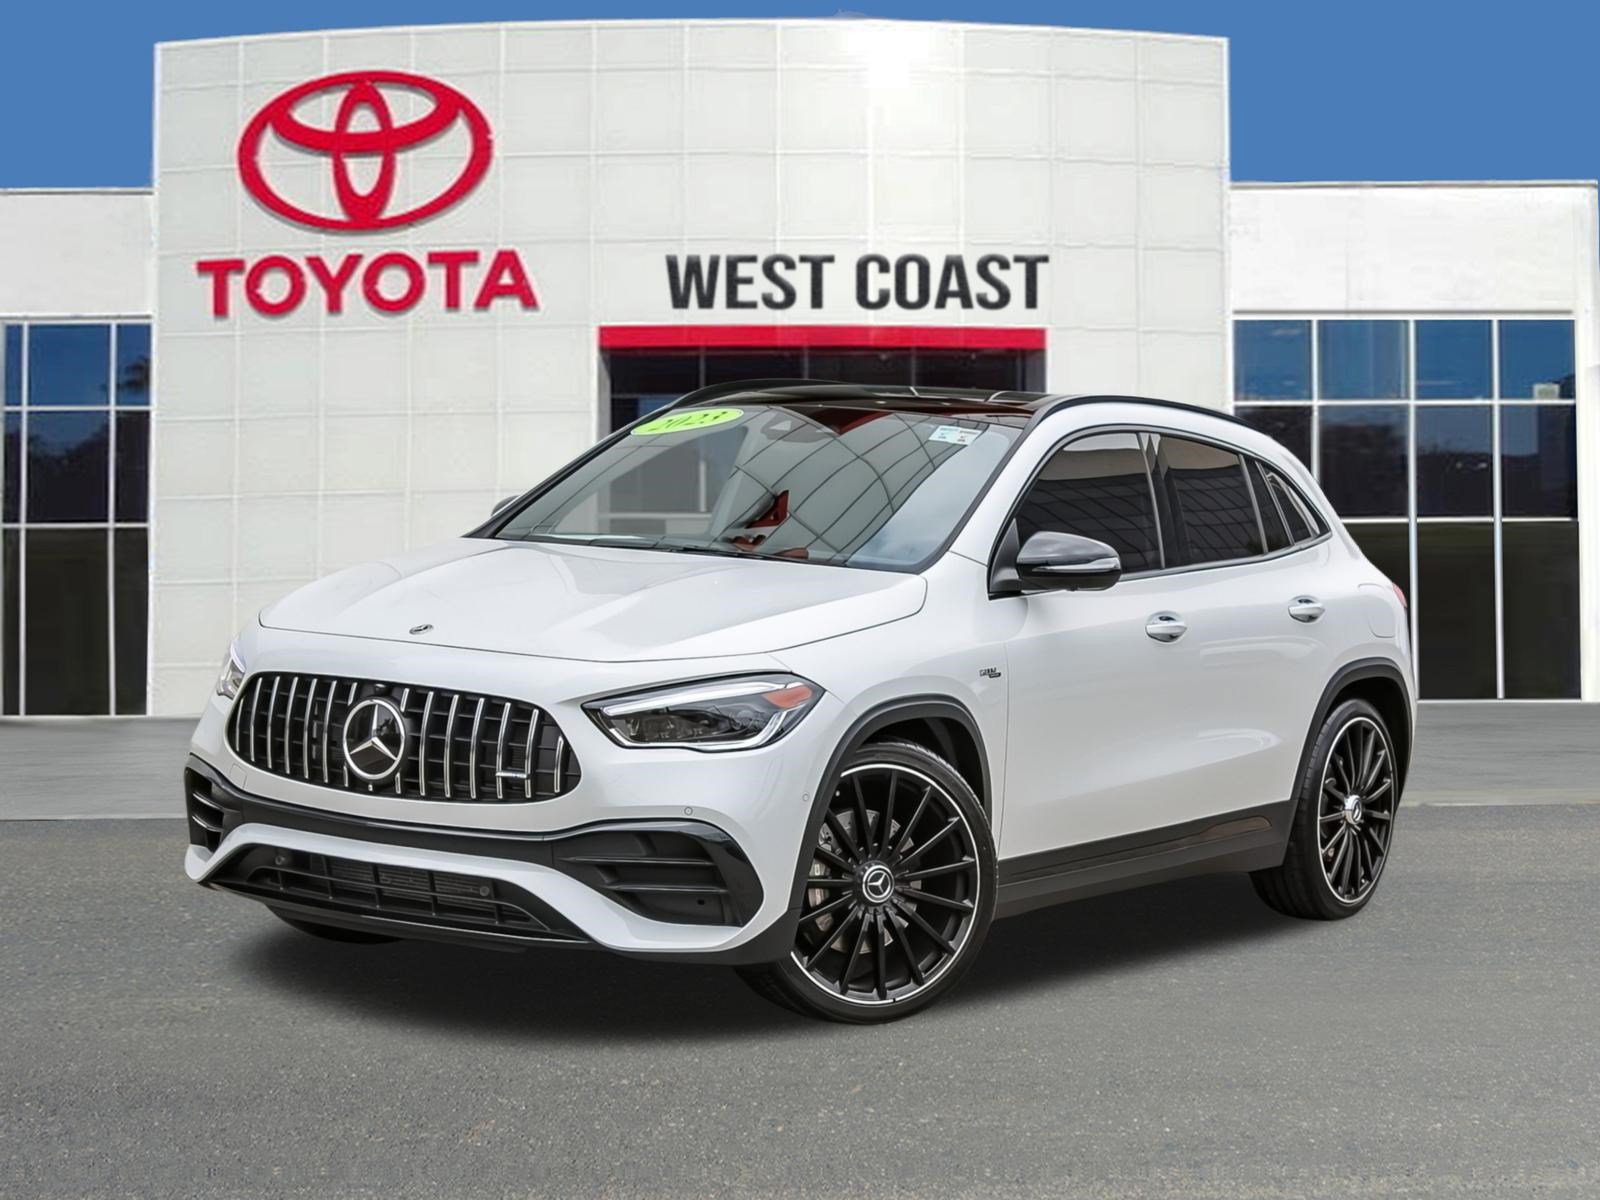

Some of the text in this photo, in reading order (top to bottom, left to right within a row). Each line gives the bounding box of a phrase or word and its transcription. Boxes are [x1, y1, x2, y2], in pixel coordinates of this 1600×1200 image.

[197, 250, 538, 317] TOYOTA
[666, 254, 1049, 310] WEST COAST
